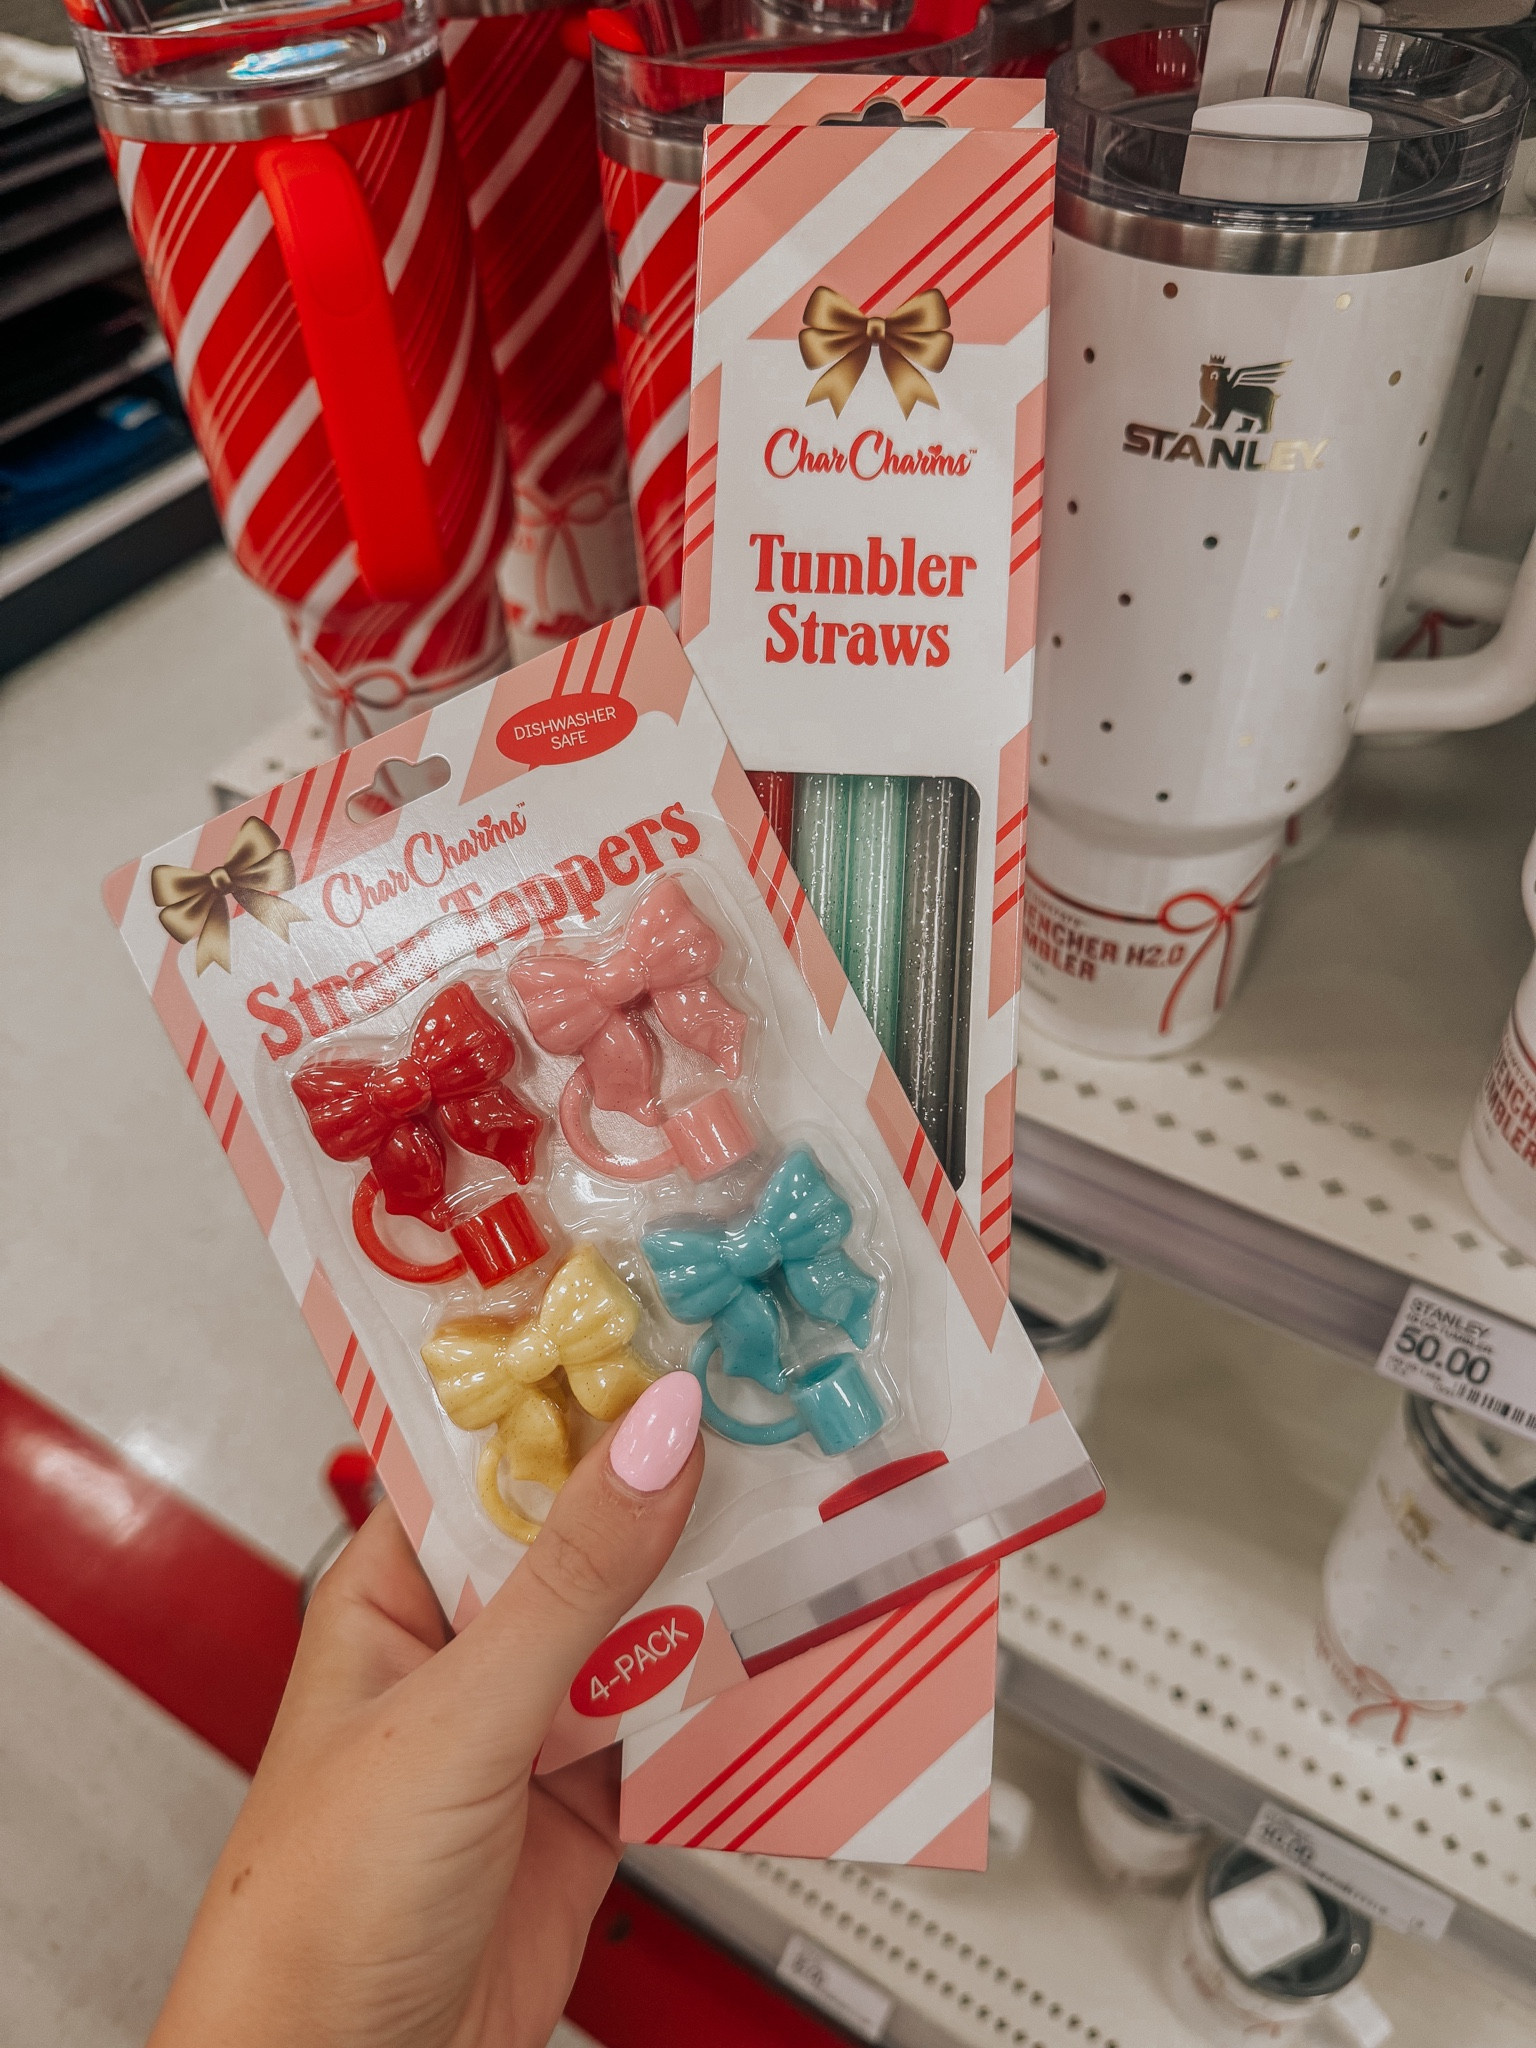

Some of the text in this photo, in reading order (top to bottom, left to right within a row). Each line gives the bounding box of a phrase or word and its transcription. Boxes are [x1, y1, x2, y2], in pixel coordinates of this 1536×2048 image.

[1123, 422, 1329, 472] STANLEY
[748, 533, 978, 598] Tumbler
[765, 603, 951, 668] Straws
[513, 706, 617, 741] DISHWASHER
[551, 729, 588, 750] SAFE
[246, 801, 702, 1062] Straw Toppers
[1023, 900, 1120, 965] ENCHER
[1024, 924, 1097, 983] MBLER
[1409, 1296, 1490, 1339] STANLEY
[1394, 1325, 1492, 1385] 50.00
[590, 1617, 690, 1701] 4-PACK
